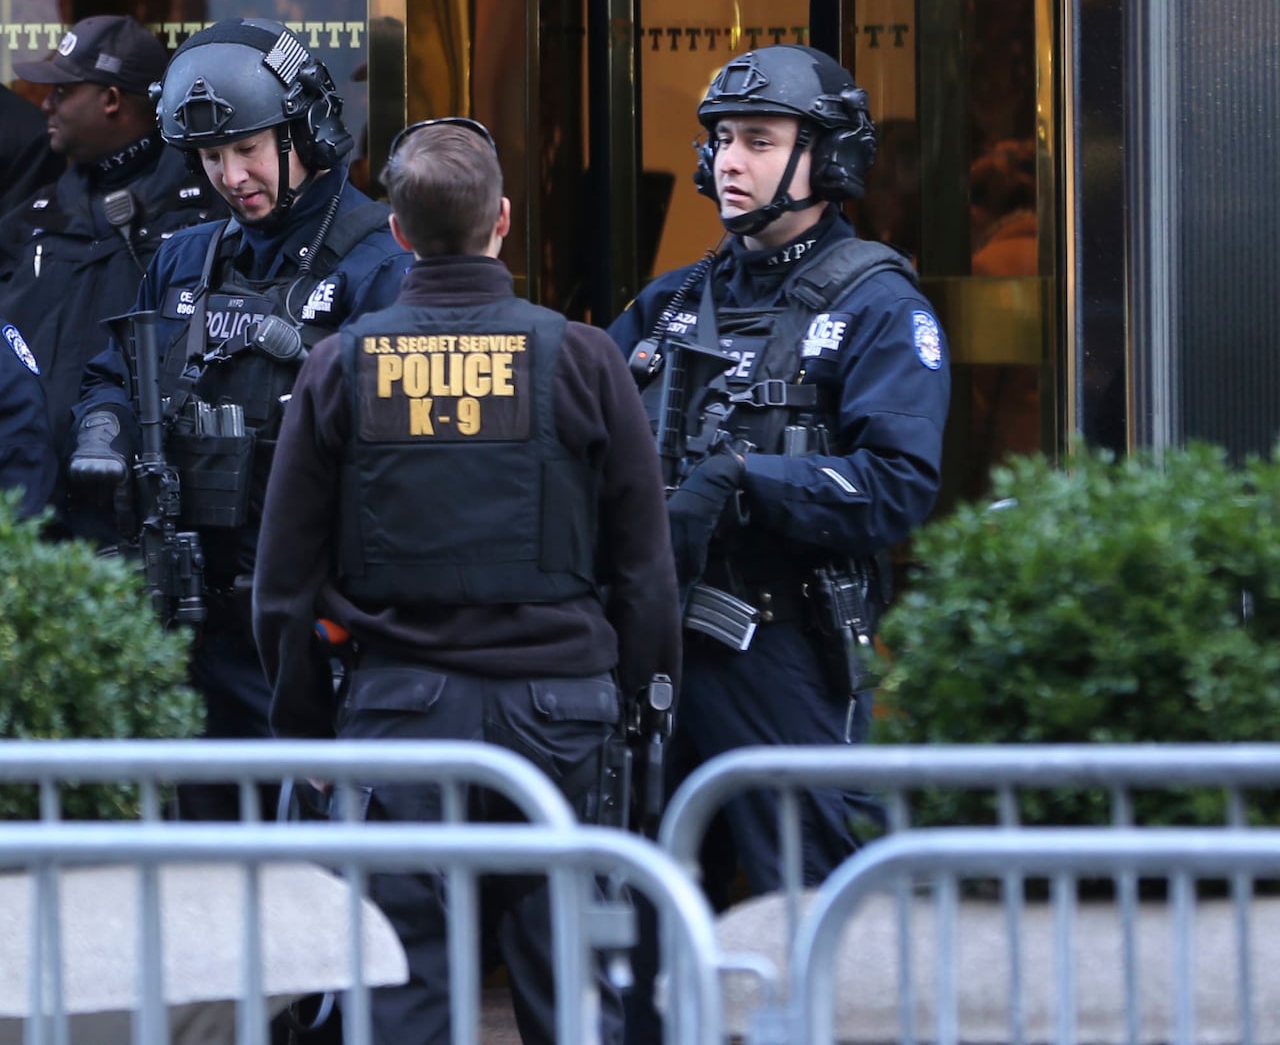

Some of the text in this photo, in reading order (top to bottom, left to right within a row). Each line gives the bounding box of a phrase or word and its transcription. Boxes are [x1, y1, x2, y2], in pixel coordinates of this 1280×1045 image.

[363, 335, 527, 353] U.S. SECRET SERVICE
[377, 353, 515, 397] POLICE
